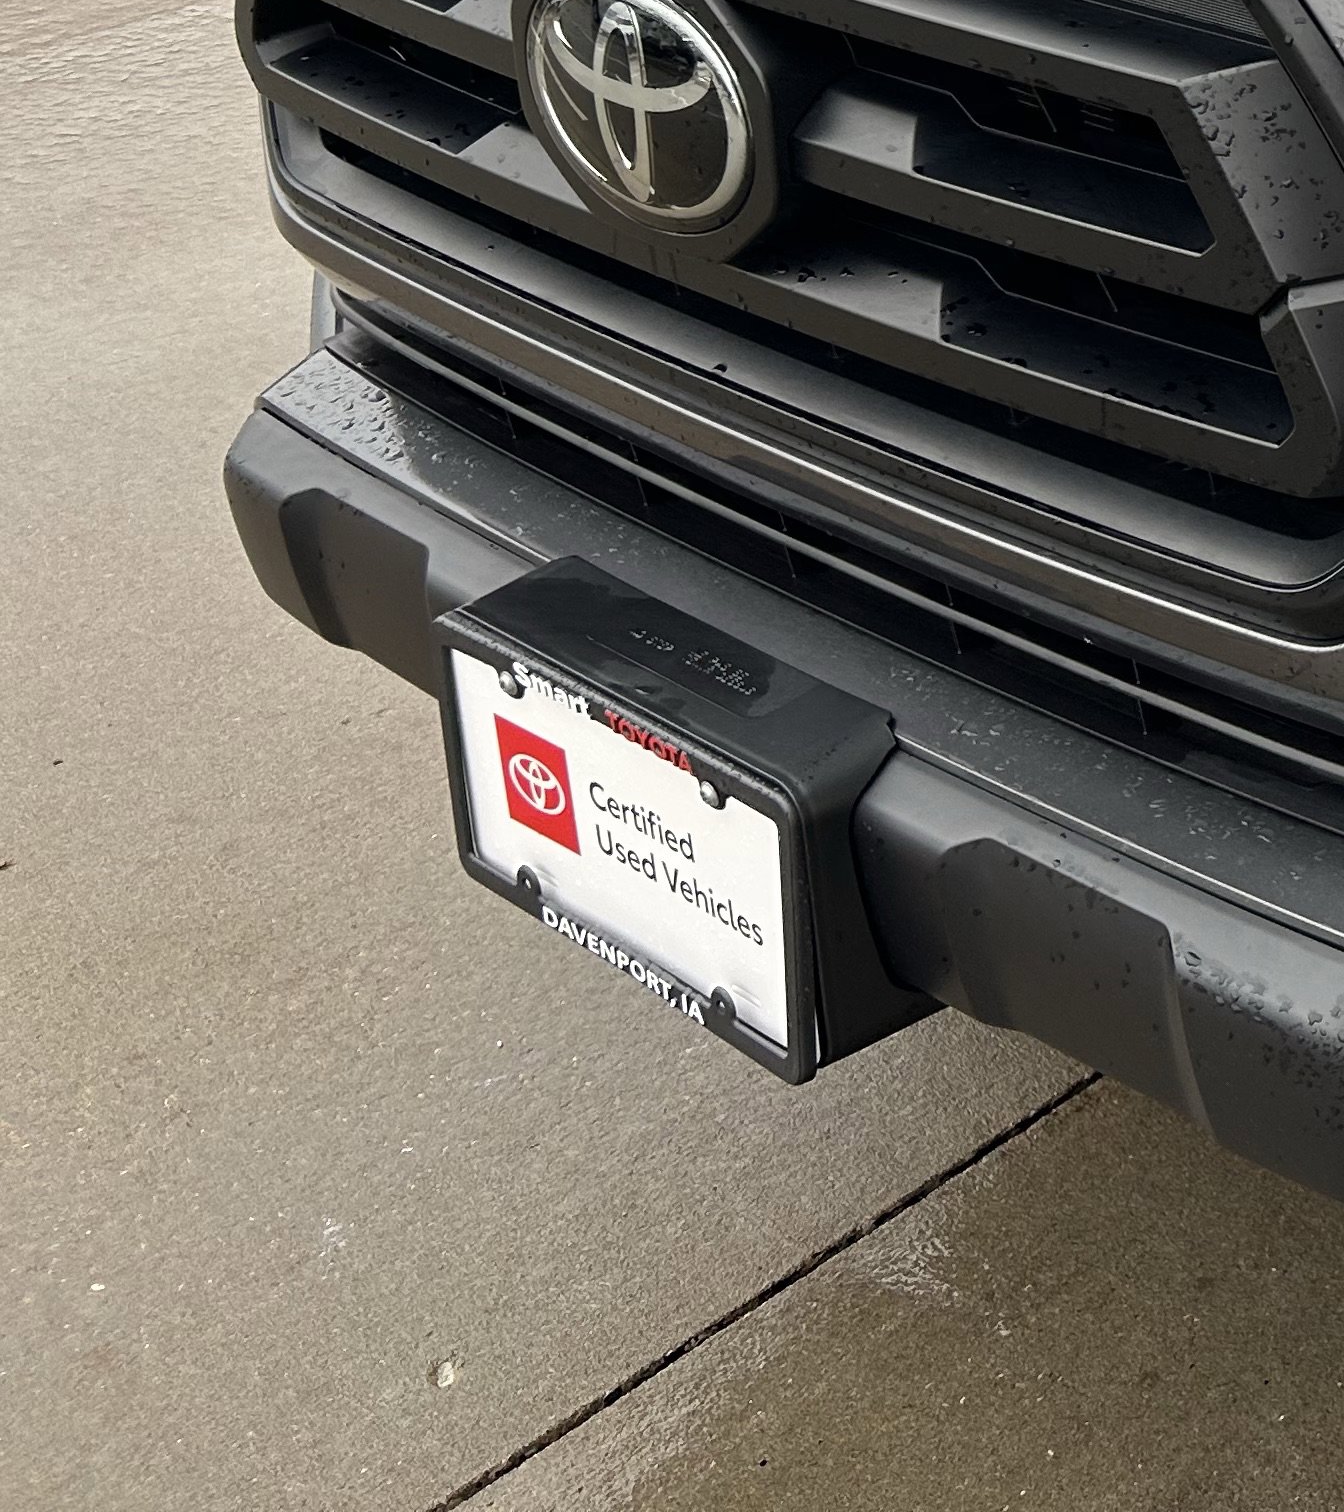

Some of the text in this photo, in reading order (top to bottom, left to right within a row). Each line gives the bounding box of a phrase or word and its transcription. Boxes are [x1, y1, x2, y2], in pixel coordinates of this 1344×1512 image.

[511, 661, 592, 718] Smart
[604, 709, 694, 774] TOYOTA
[590, 782, 695, 863] Certified
[596, 824, 764, 946] Used Vehicles
[542, 906, 705, 1026] DAVENPORT, IA
